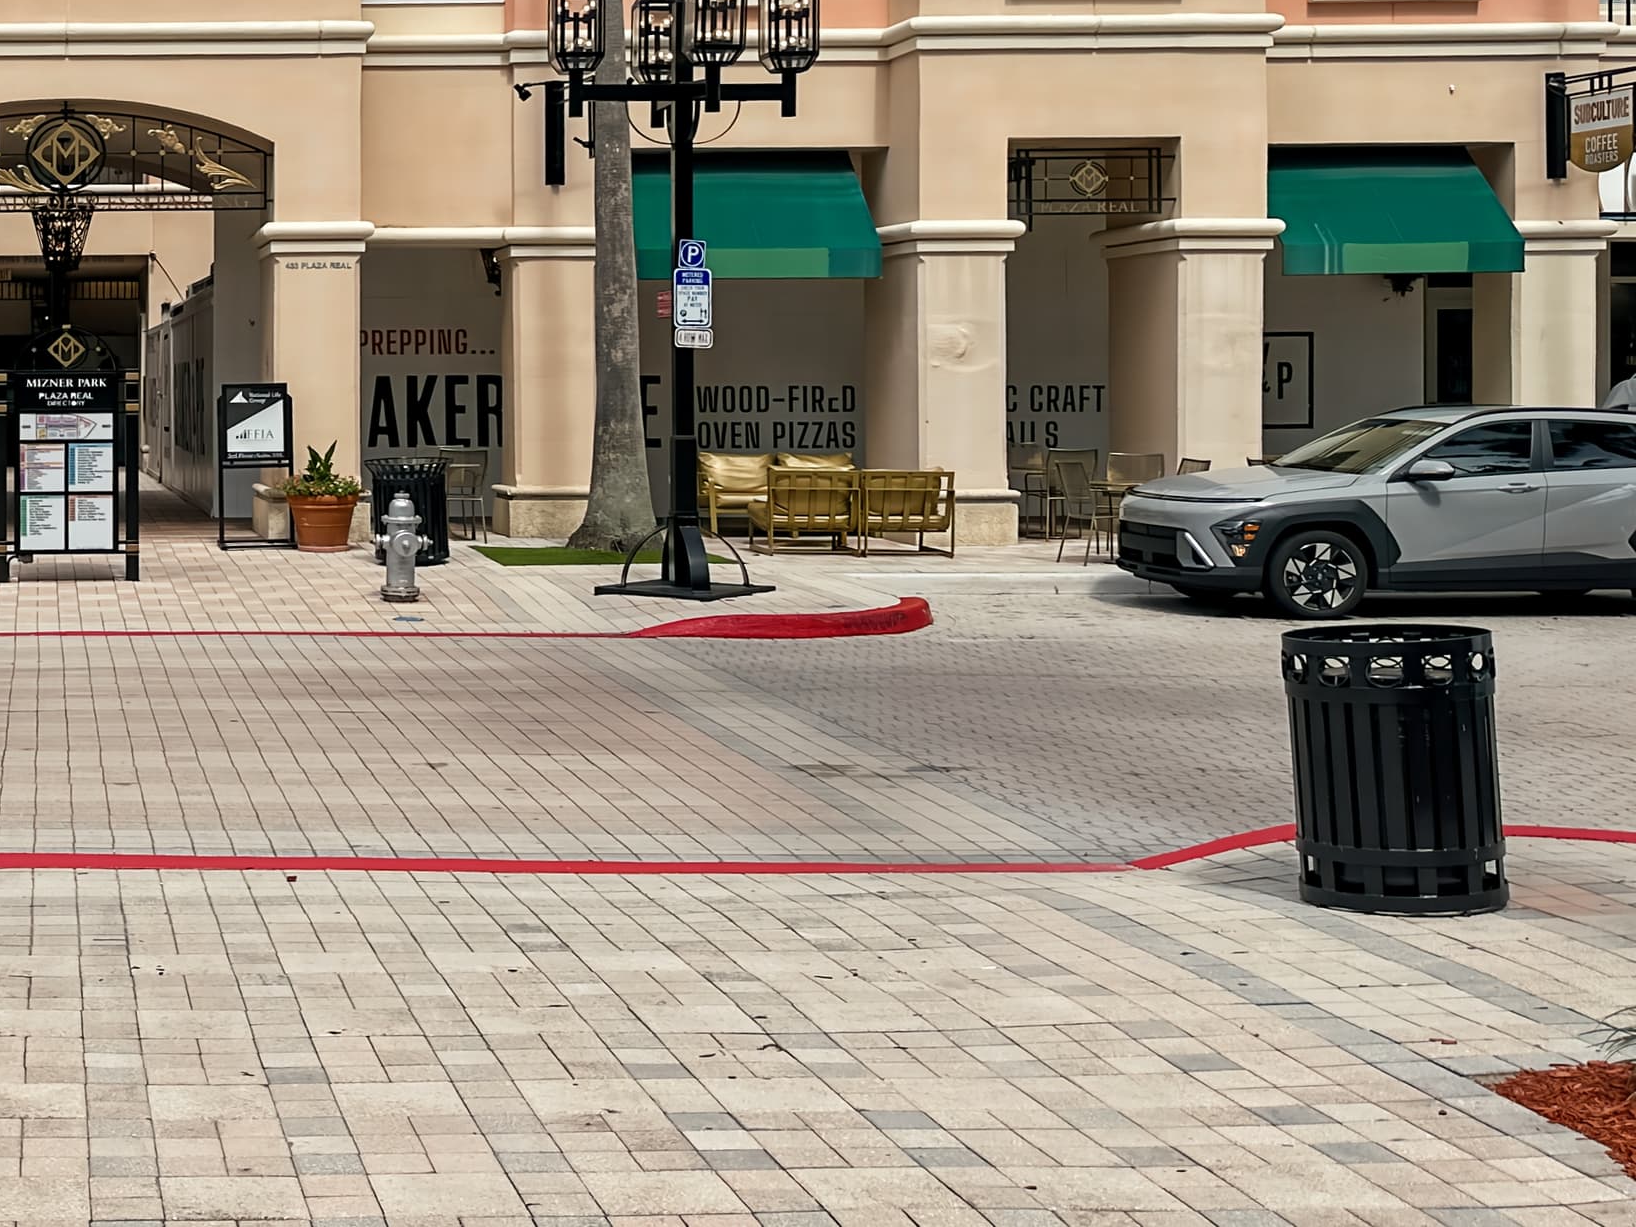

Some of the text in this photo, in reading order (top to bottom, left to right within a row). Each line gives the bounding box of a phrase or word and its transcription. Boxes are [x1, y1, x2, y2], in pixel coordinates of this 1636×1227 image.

[1574, 96, 1630, 125] SUBCULTURE
[1585, 133, 1618, 153] COFFEE
[1585, 150, 1619, 165] ROASTERS
[1040, 201, 1140, 213] PLAZA REAL
[687, 245, 699, 263] P
[360, 328, 496, 355] PREPPING...
[26, 378, 108, 388] MIZNER PARK
[38, 392, 94, 400] PLAZA REAL
[1029, 384, 1106, 413] CRAFT
[697, 421, 856, 449] OVEN PIZZAS
